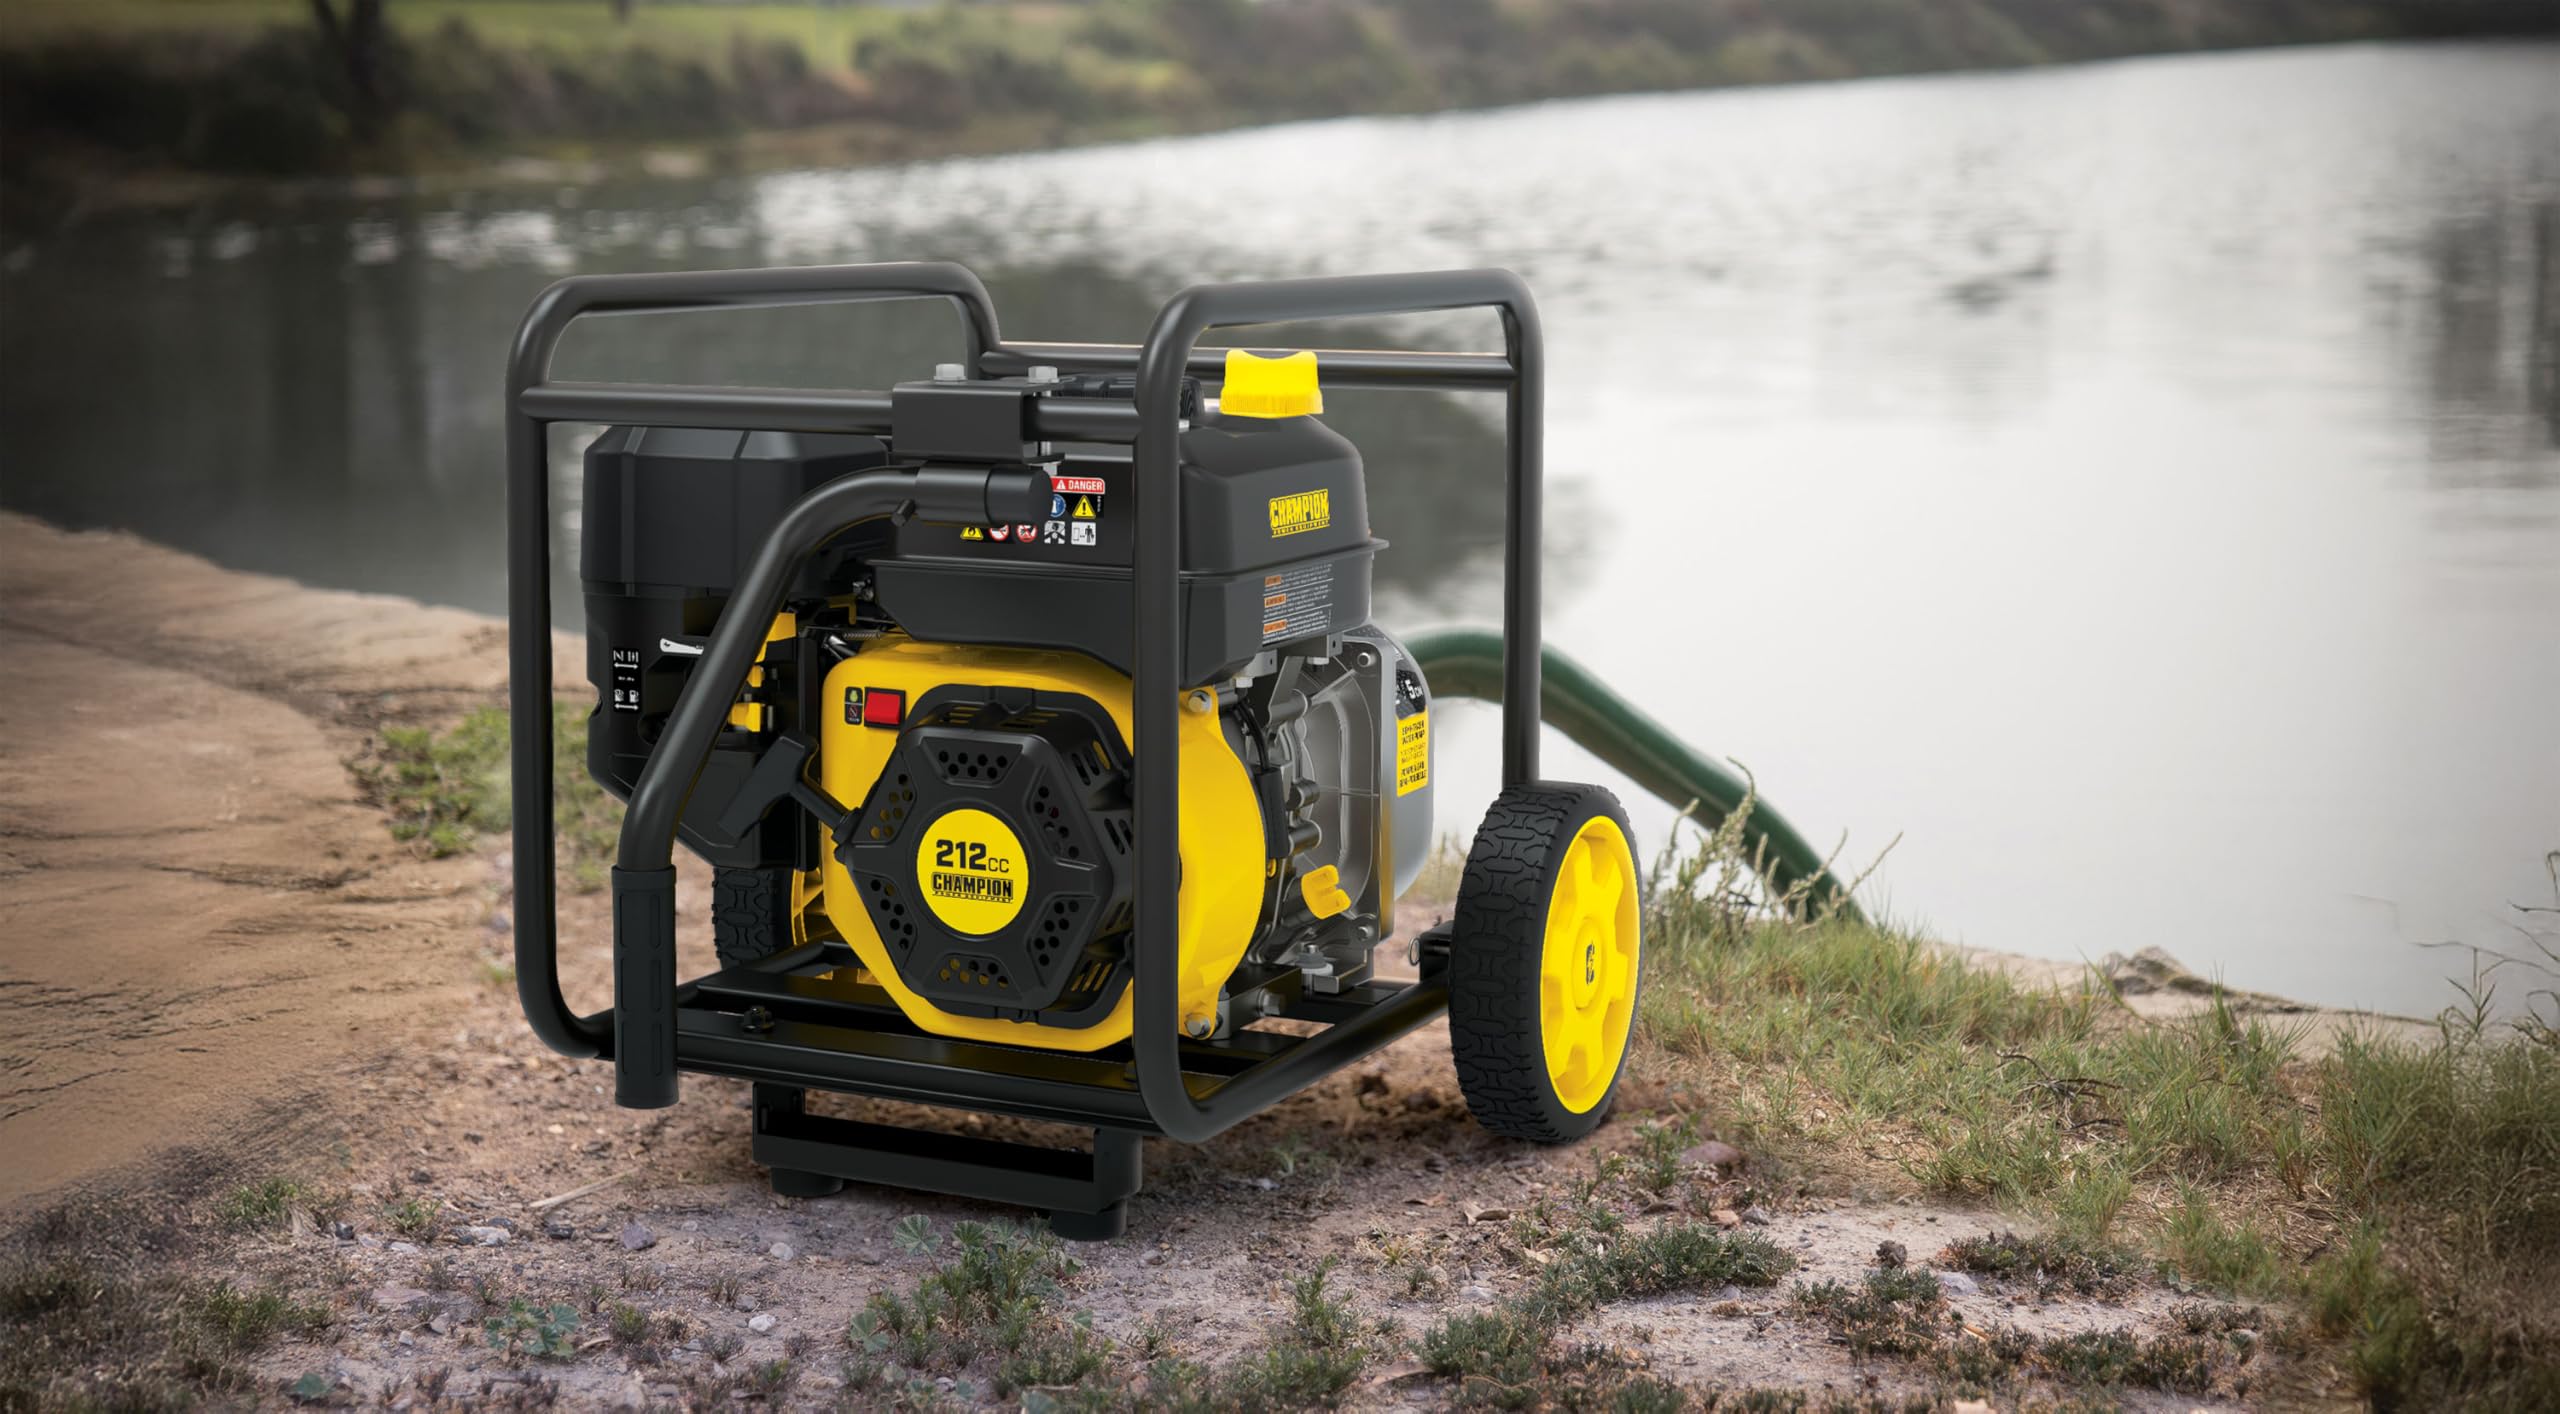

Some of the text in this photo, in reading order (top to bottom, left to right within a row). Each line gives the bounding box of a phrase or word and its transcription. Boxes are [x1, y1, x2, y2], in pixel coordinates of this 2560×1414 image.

[1068, 479, 1102, 490] DANGER
[1269, 491, 1330, 528] CHAMPION
[932, 873, 1012, 898] CHAMPION
